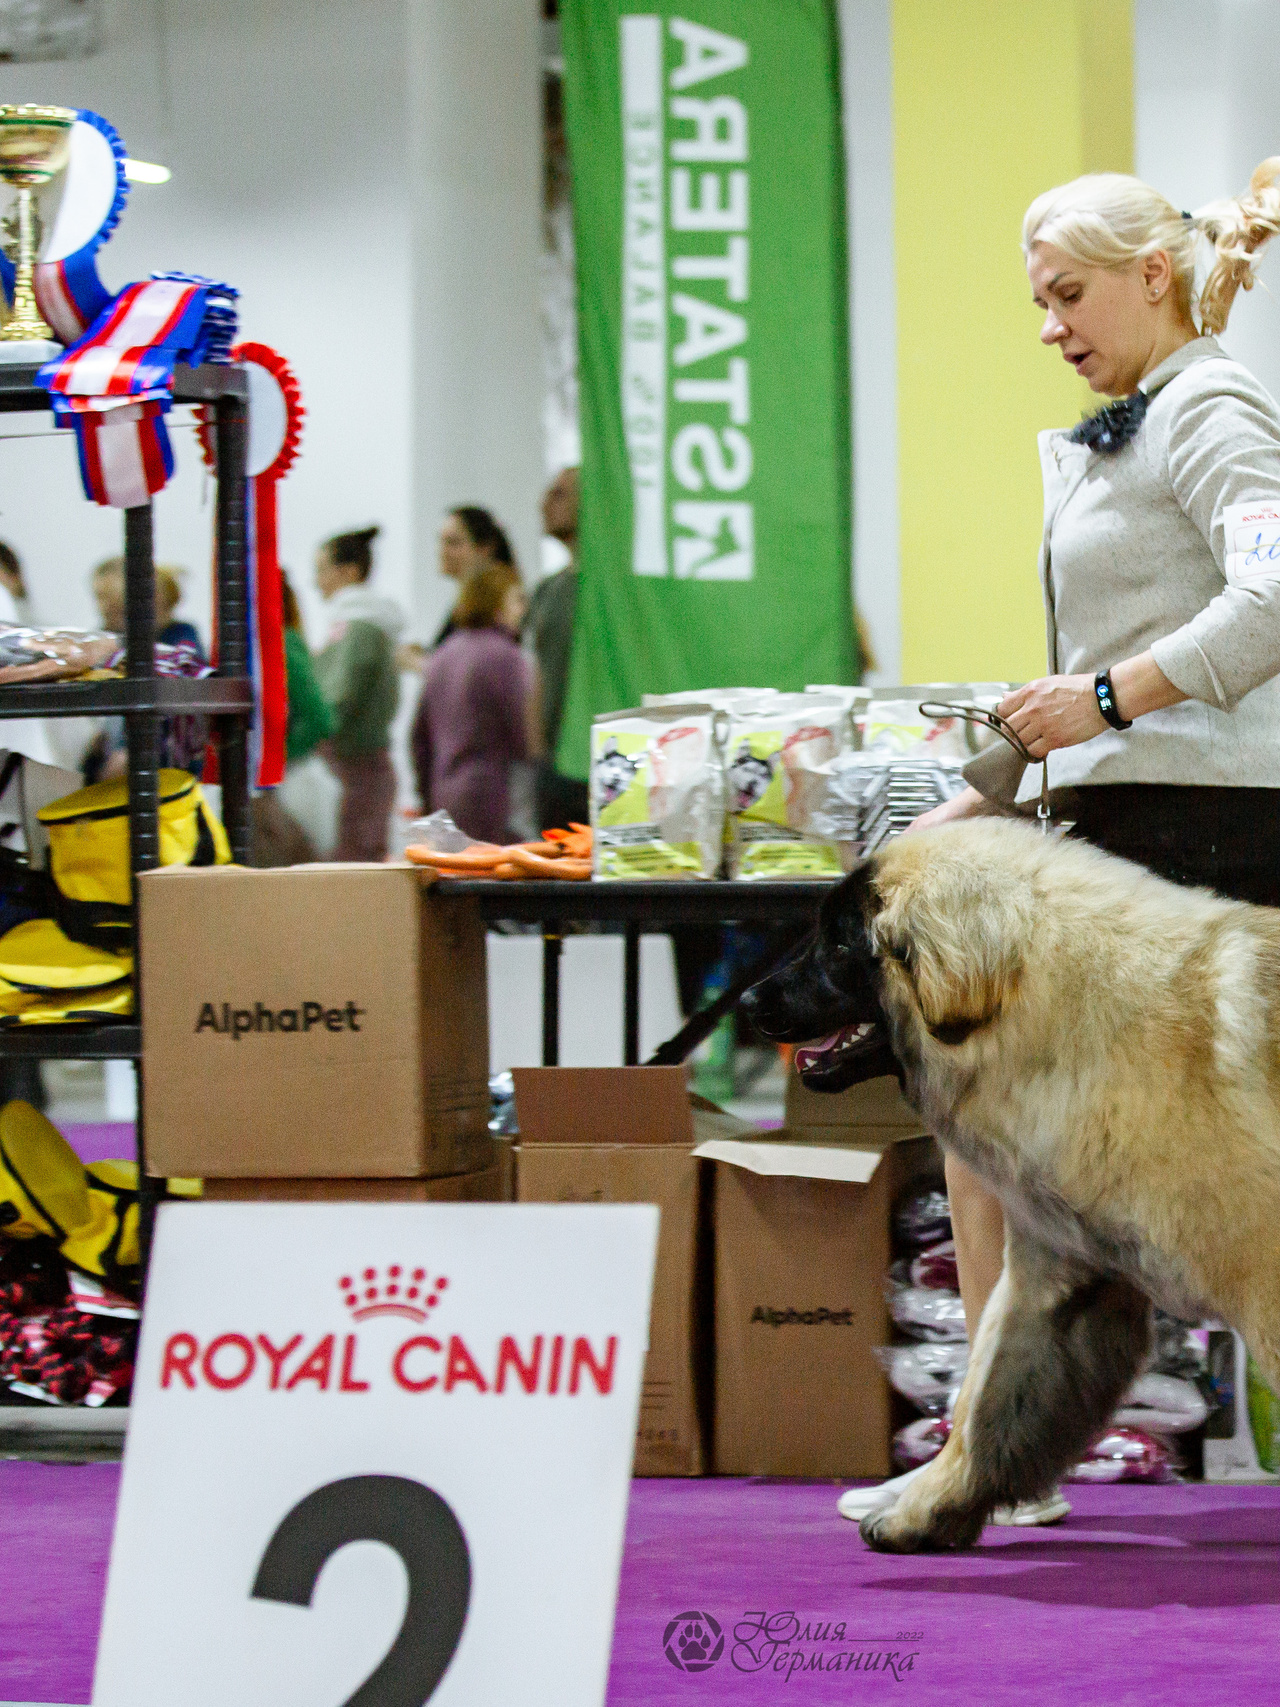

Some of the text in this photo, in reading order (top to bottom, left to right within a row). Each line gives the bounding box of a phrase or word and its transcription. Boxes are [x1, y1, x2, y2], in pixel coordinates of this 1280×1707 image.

[194, 1000, 366, 1041] AlphaPet
[750, 1306, 856, 1330] AlphaPet
[160, 1331, 371, 1391] ROYAL
[390, 1333, 619, 1396] CANIN
[249, 1474, 473, 1707] 2
